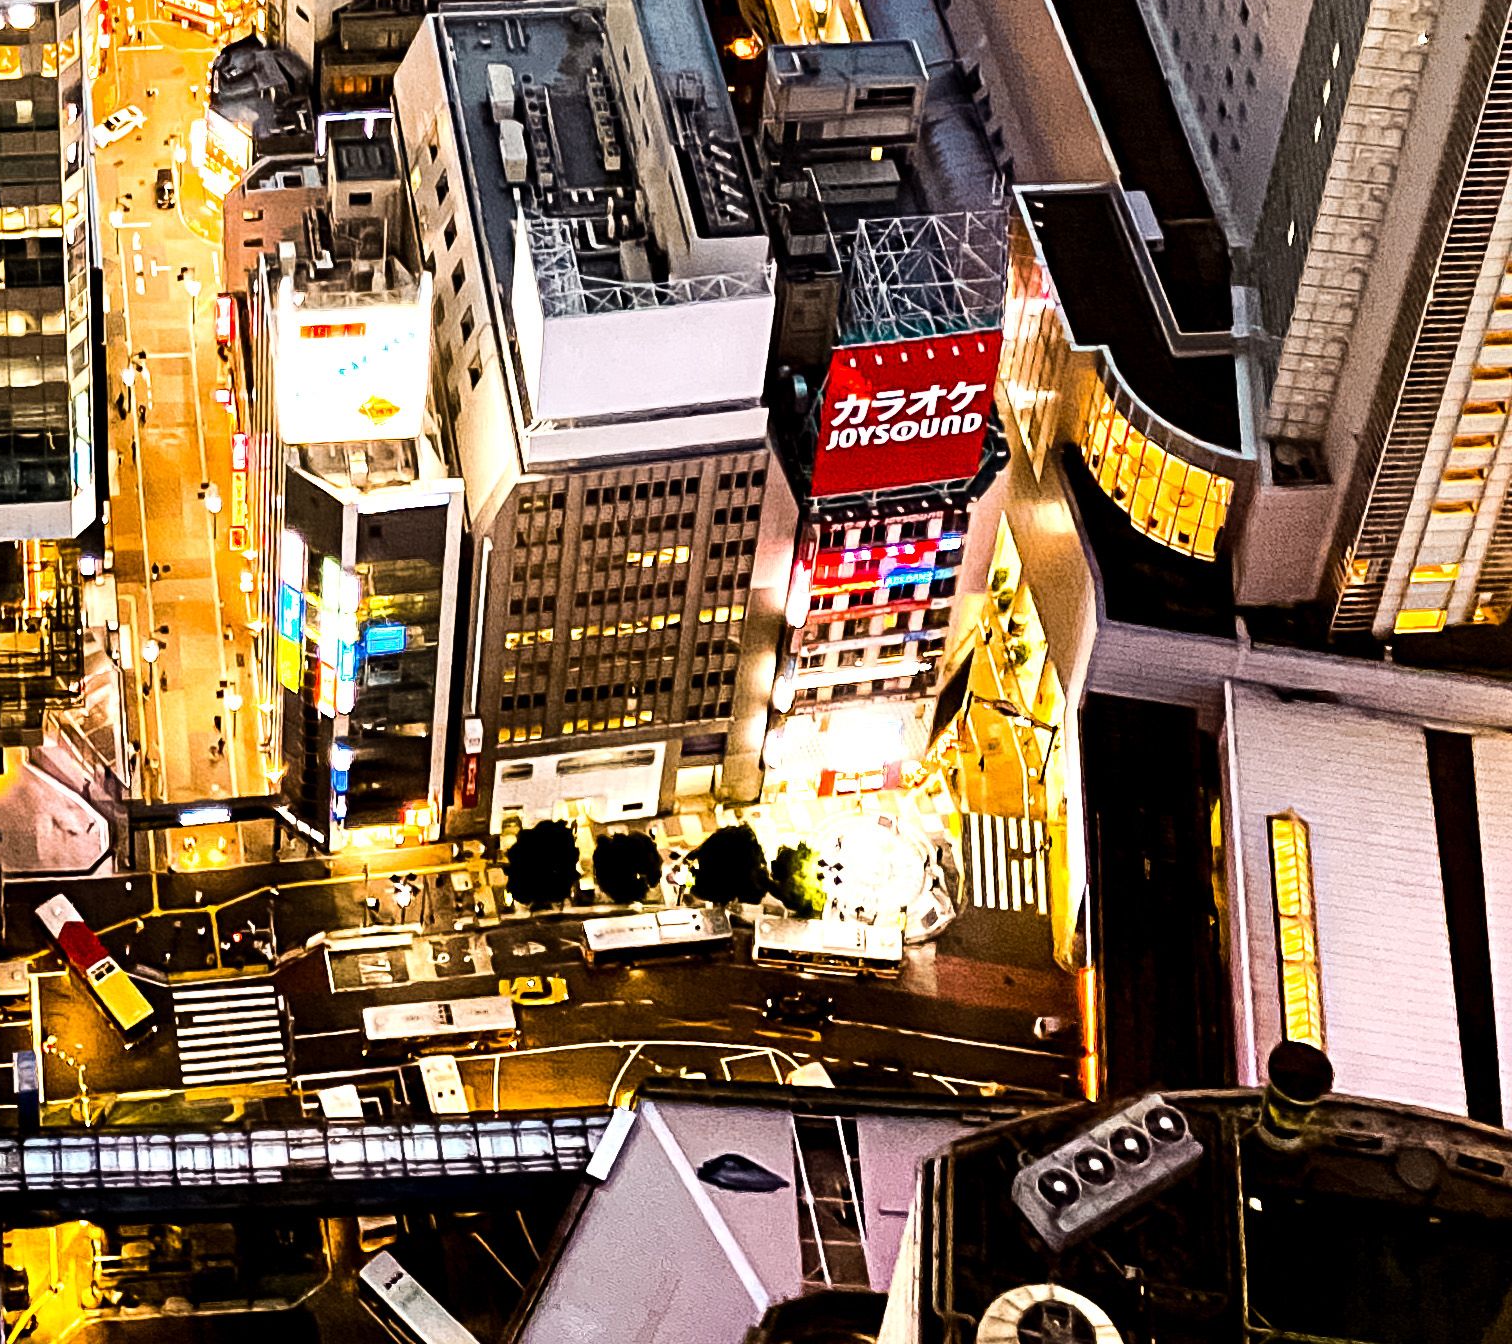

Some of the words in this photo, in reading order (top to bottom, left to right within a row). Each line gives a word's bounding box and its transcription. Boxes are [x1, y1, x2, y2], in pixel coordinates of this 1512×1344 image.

[830, 381, 987, 427] カラオケ
[825, 412, 983, 451] JOYSOUND
